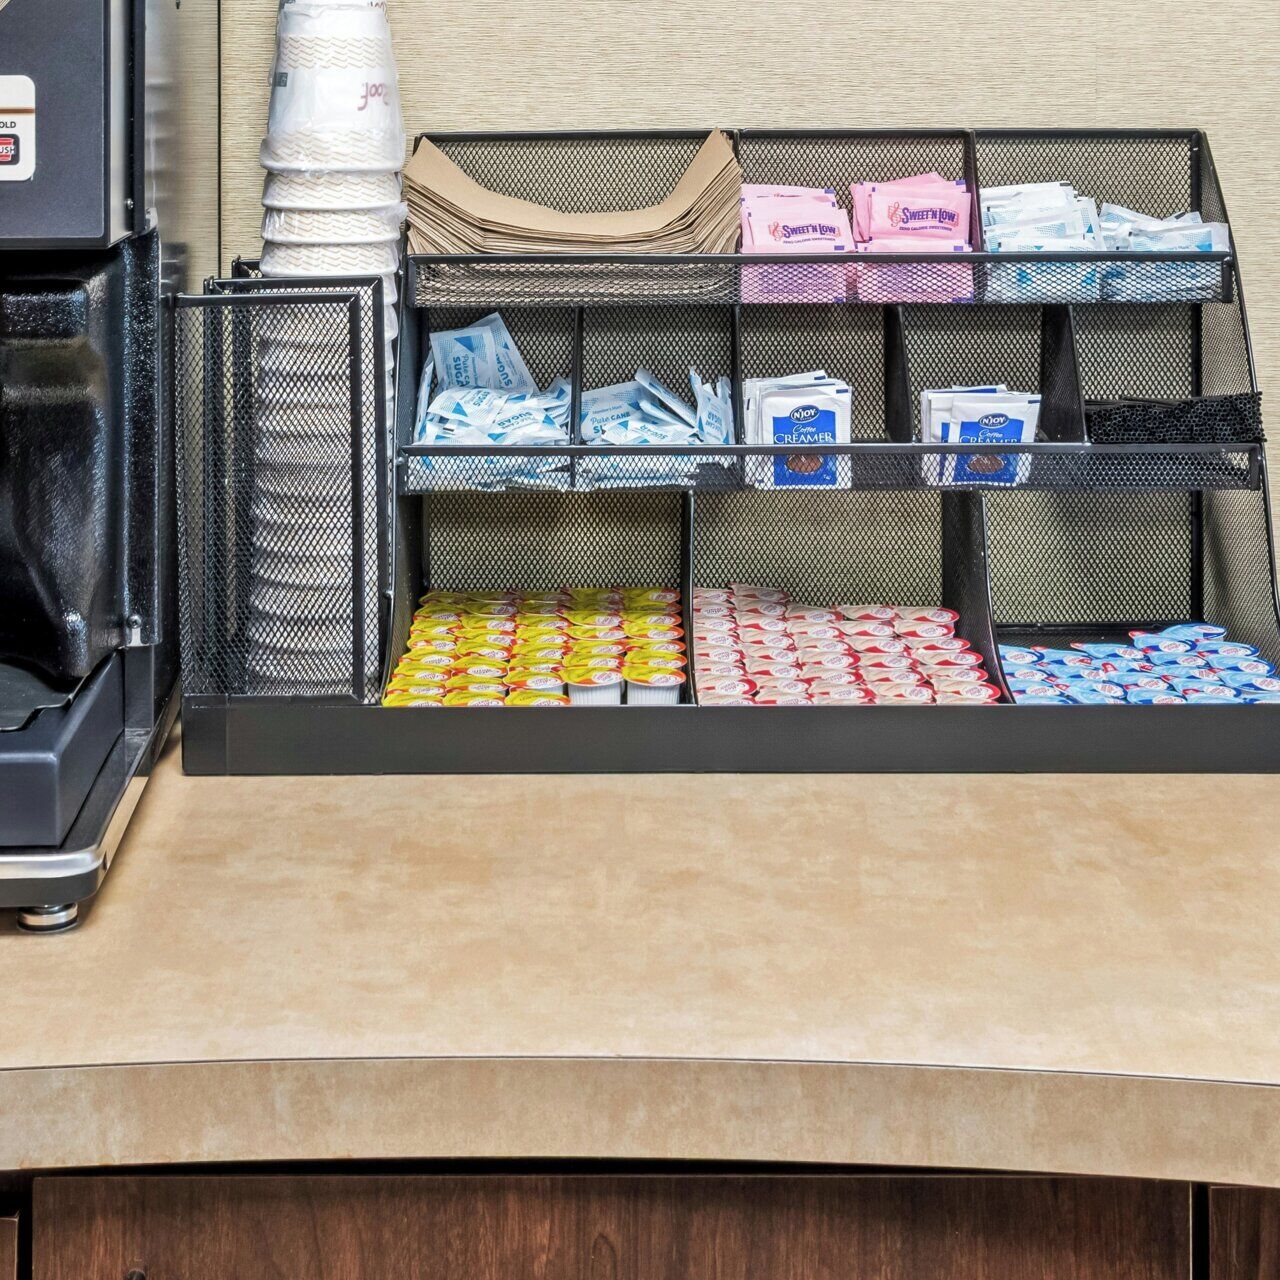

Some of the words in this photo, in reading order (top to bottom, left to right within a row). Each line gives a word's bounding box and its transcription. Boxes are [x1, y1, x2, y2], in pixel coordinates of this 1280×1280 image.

[453, 356, 464, 386] SUGA
[495, 353, 513, 387] SUGA
[610, 411, 631, 421] CANE
[792, 424, 817, 434] Coffee
[978, 429, 1004, 438] Coffee
[774, 432, 834, 444] CREAMER
